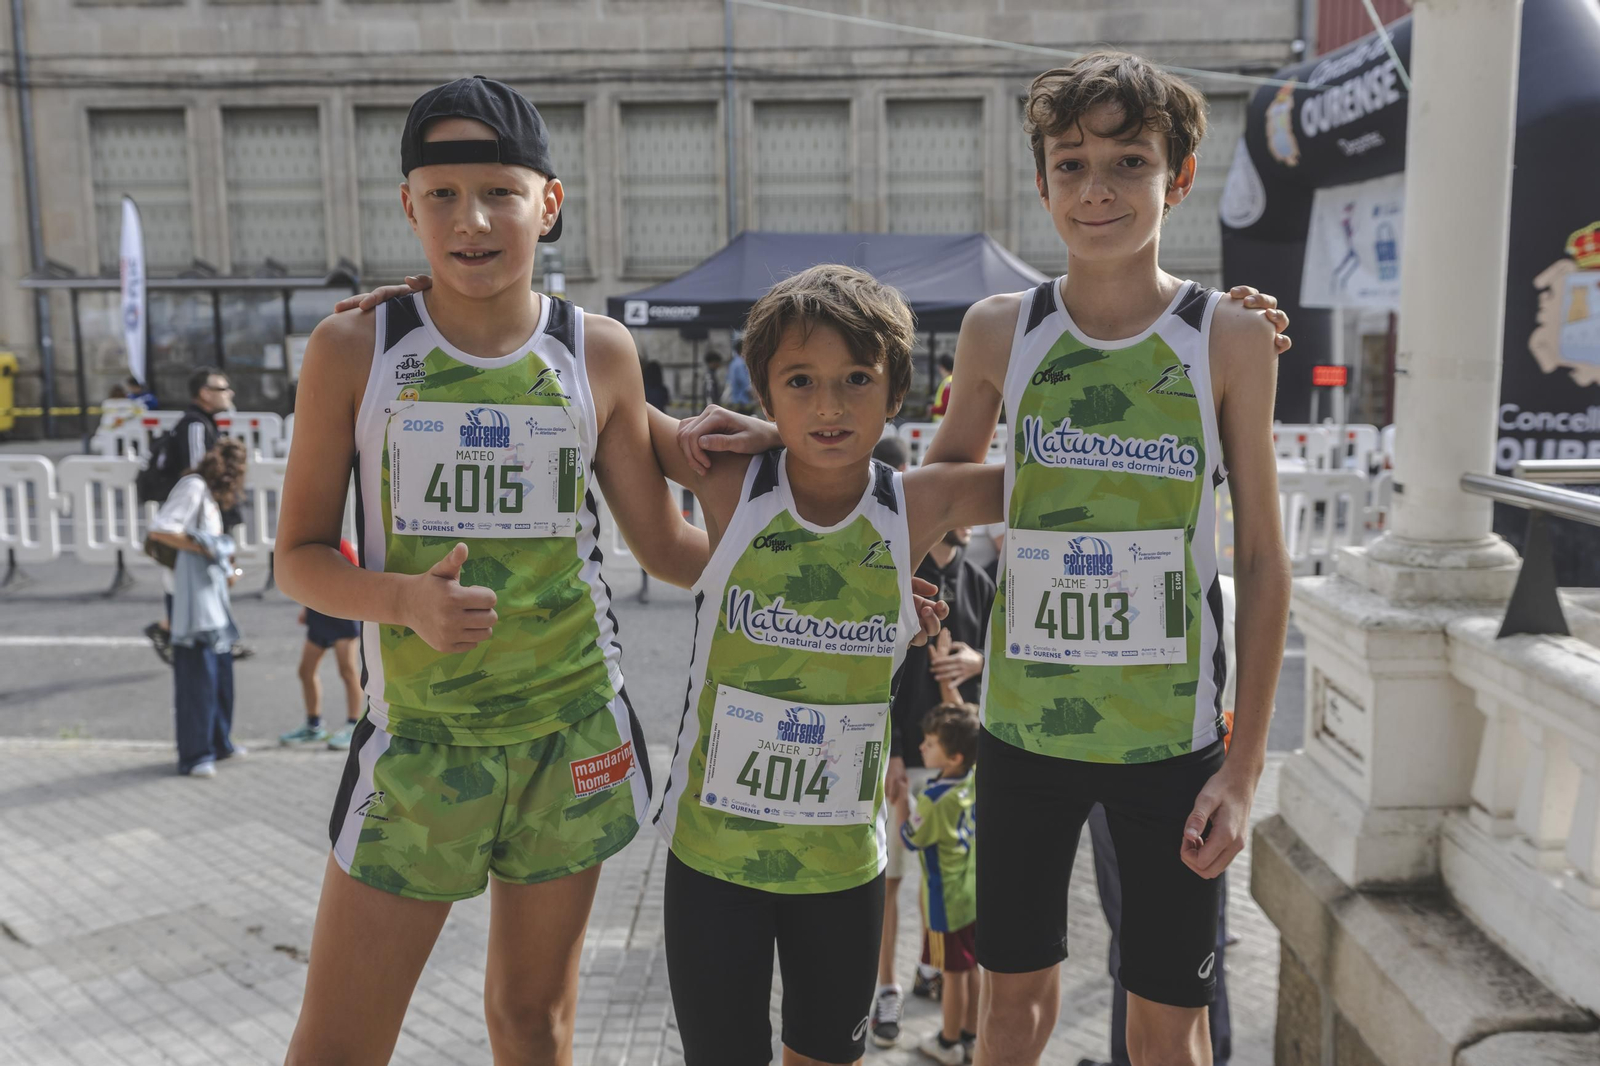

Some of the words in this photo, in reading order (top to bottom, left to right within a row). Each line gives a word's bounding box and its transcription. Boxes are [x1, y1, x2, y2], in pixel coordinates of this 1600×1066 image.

[1301, 58, 1400, 137] OURENSE
[395, 370, 426, 380] Legado
[403, 420, 444, 432] 2026
[460, 424, 510, 437] correndo
[1025, 418, 1194, 465] Natursueño
[456, 451, 494, 460] MATEO
[1056, 456, 1066, 464] Lo
[1070, 456, 1108, 467] natural
[1128, 460, 1164, 474] dormir
[1168, 466, 1193, 478] bien
[424, 464, 523, 513] 4015
[771, 544, 792, 553] sport
[1017, 547, 1050, 560] 2026
[1064, 554, 1112, 565] correndo
[1052, 578, 1086, 588] JAIME
[1095, 579, 1109, 589] JJ
[730, 589, 897, 642] Natursueño
[1035, 591, 1129, 640] 4013
[765, 633, 778, 642] Lo
[782, 636, 821, 649] natural
[825, 641, 837, 650] es
[840, 641, 874, 653] dormir
[726, 705, 763, 722] 2026
[778, 720, 825, 735] correndo
[758, 740, 800, 755] JAVIER
[808, 748, 821, 756] JJ
[578, 772, 610, 791] home
[737, 751, 829, 803] 4014
[731, 804, 760, 815] OURENSE
